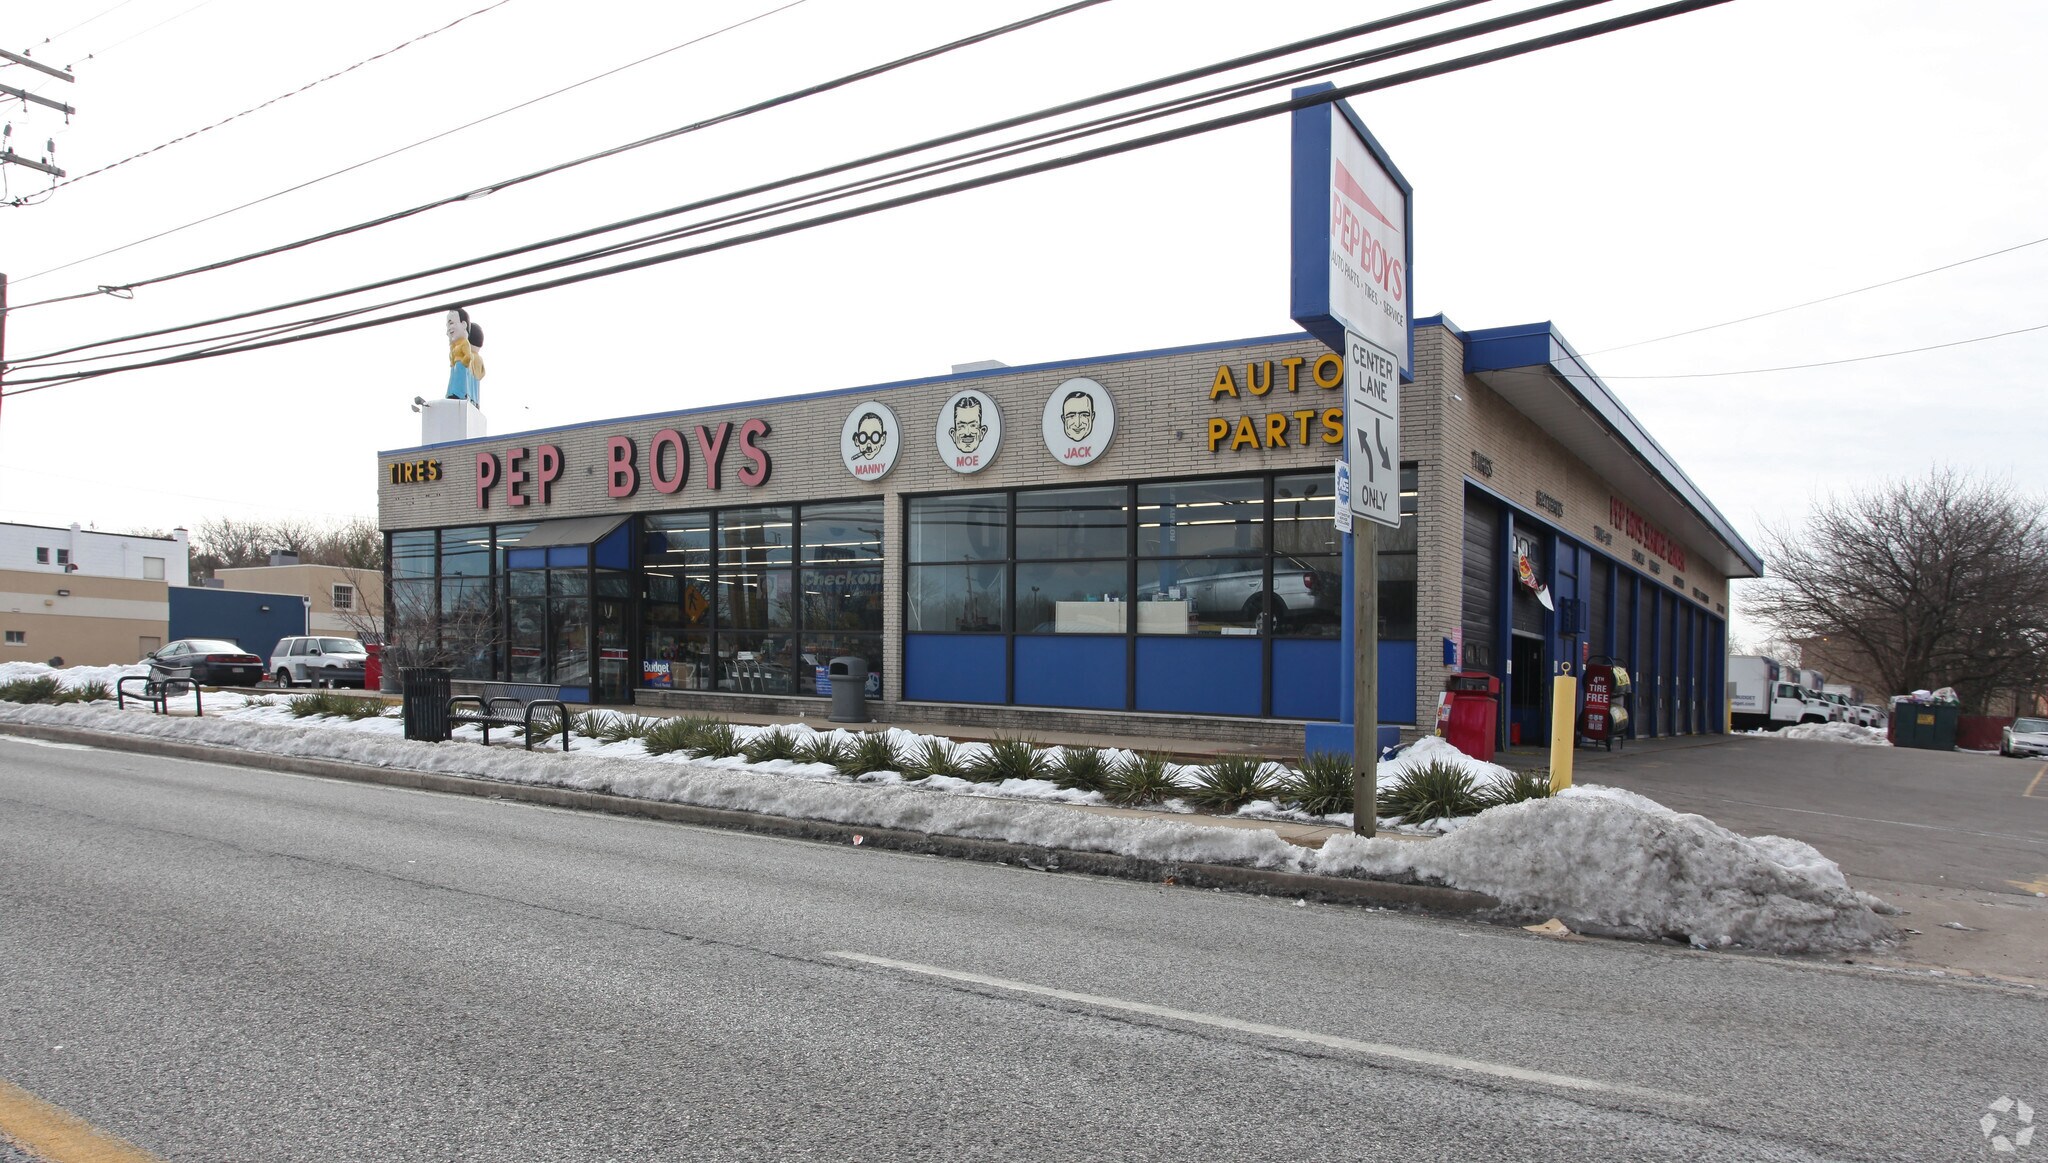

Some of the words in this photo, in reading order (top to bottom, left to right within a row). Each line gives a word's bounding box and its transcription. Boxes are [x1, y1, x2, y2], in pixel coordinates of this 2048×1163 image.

[1331, 194, 1360, 257] PEP
[1360, 226, 1403, 302] BOYS
[1331, 249, 1345, 273] AUTO
[1344, 262, 1360, 288] PARTS
[1364, 282, 1378, 306] TIRES
[1383, 301, 1404, 328] SERVICE
[1352, 343, 1393, 381] CENTER
[1208, 352, 1344, 402] AUTO
[1359, 371, 1388, 403] LANE
[1207, 407, 1344, 453] PARTS
[475, 443, 566, 510] PEP
[607, 417, 773, 499] BOYS
[956, 455, 979, 467] MOE
[1063, 446, 1092, 459] JACK
[387, 457, 443, 485] TIRES
[854, 463, 887, 476] MANNY
[1361, 484, 1388, 512] ONLY
[800, 571, 884, 586] Checkou
[643, 661, 670, 676] Budget
[1586, 693, 1609, 703] FREE
[1589, 684, 1607, 693] TIRE
